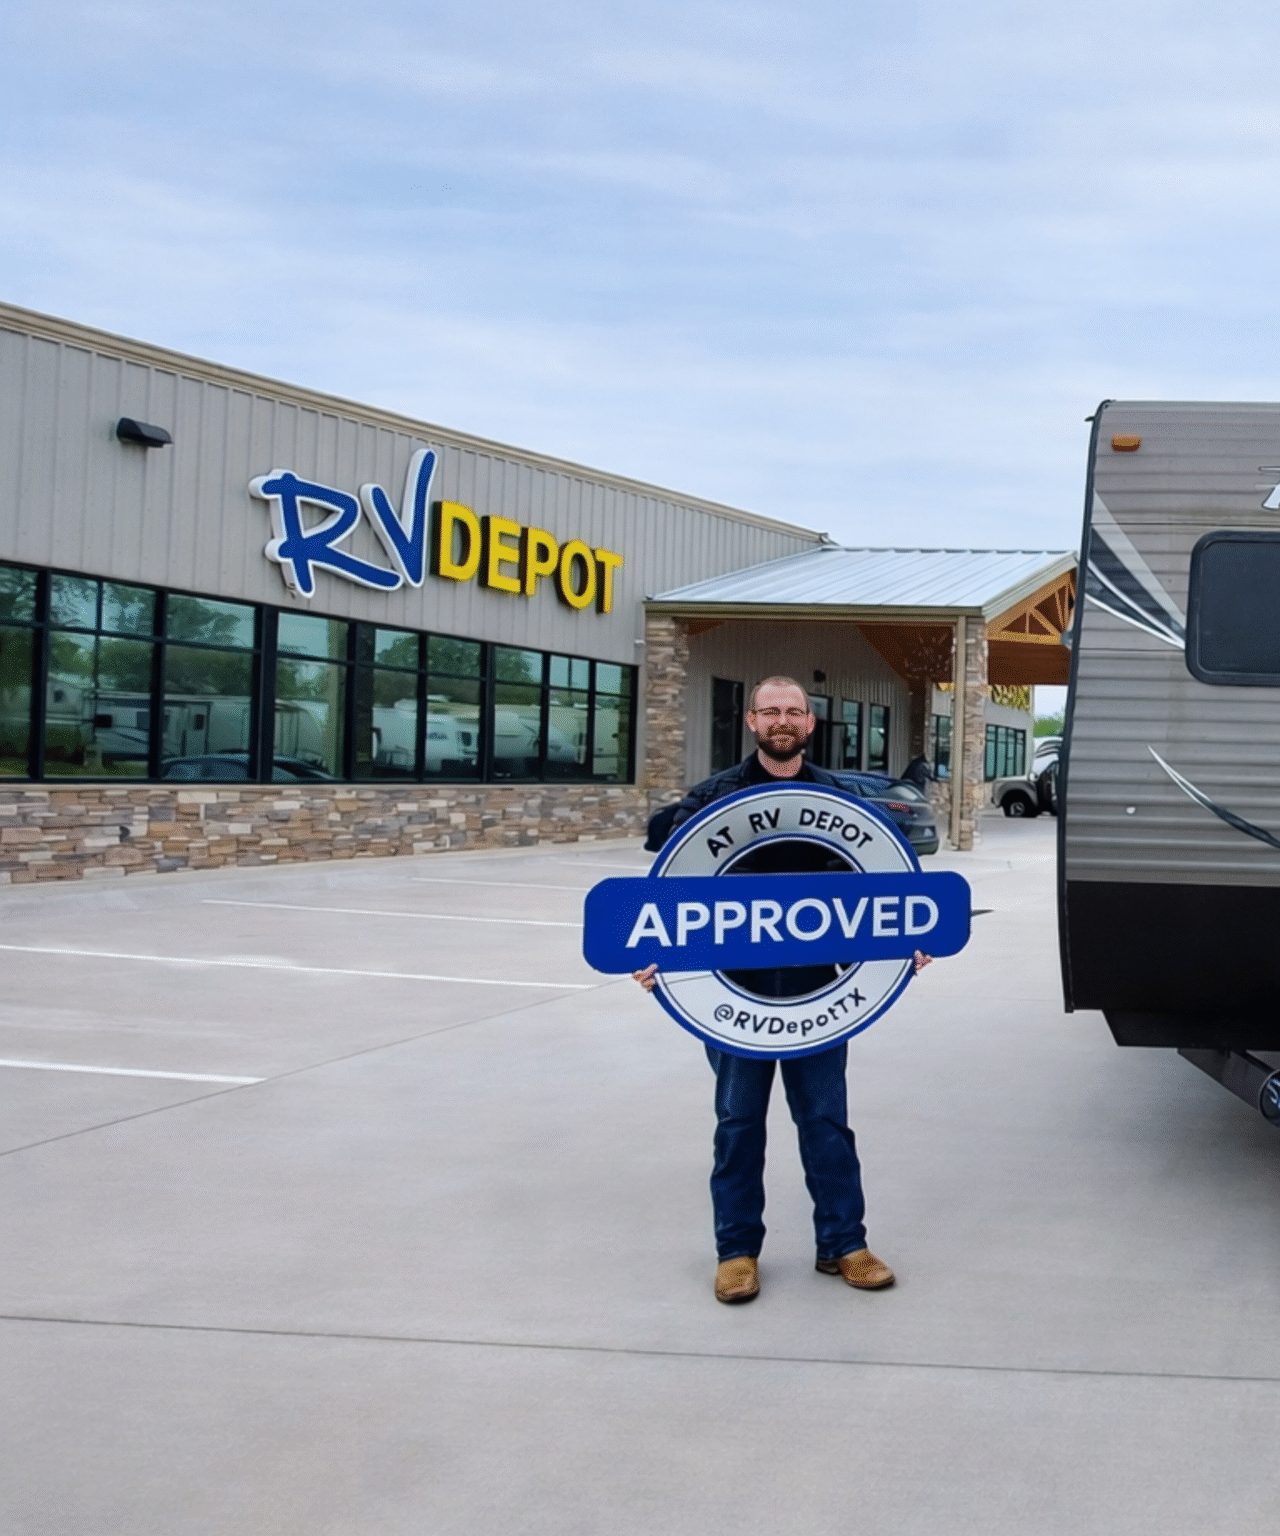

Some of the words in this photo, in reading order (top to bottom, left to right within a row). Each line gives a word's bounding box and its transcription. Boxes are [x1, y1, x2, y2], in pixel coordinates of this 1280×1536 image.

[249, 448, 436, 598] RV
[434, 499, 624, 615] DEPOT
[706, 826, 736, 859] AT
[749, 808, 781, 835] RV
[798, 808, 874, 851] DEPOT
[625, 894, 940, 949] APPROVED
[713, 987, 867, 1037] @RVDepotTX
